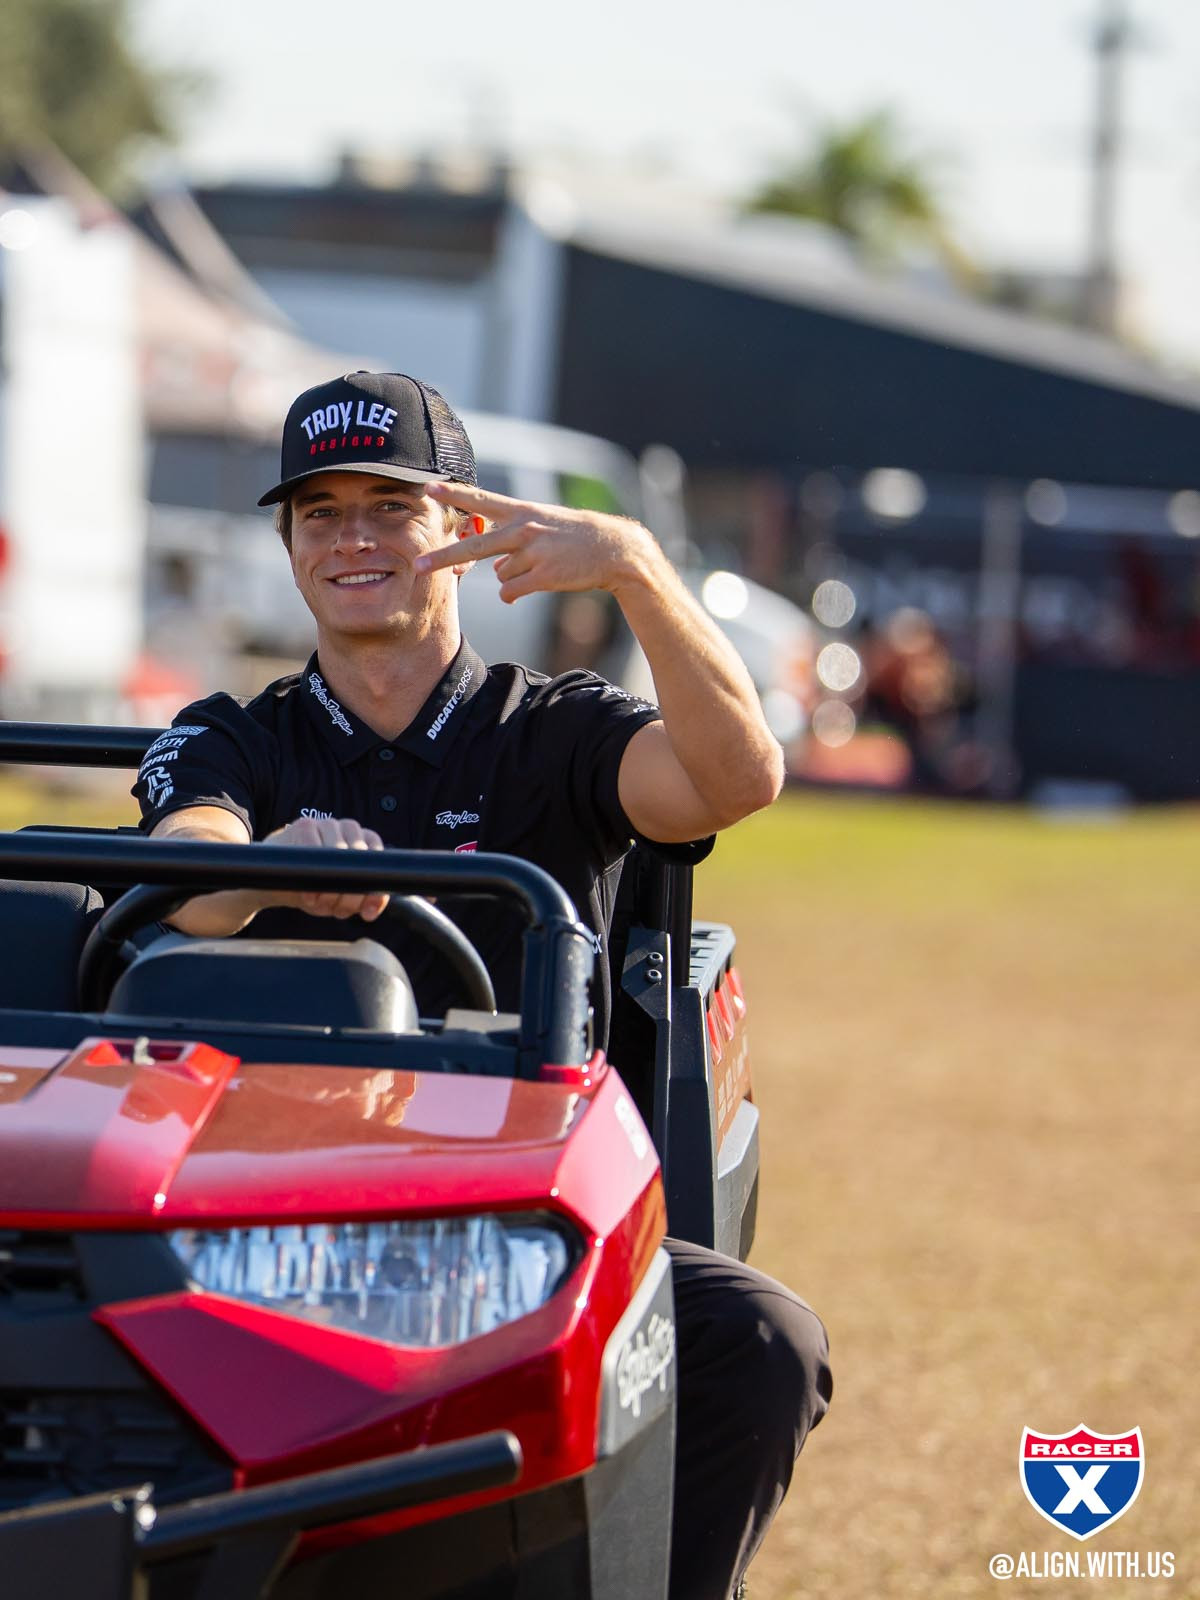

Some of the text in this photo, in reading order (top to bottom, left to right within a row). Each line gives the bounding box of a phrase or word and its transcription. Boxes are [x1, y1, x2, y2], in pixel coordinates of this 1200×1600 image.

[300, 400, 398, 440] TROY LEE
[310, 435, 385, 456] DESIGNS
